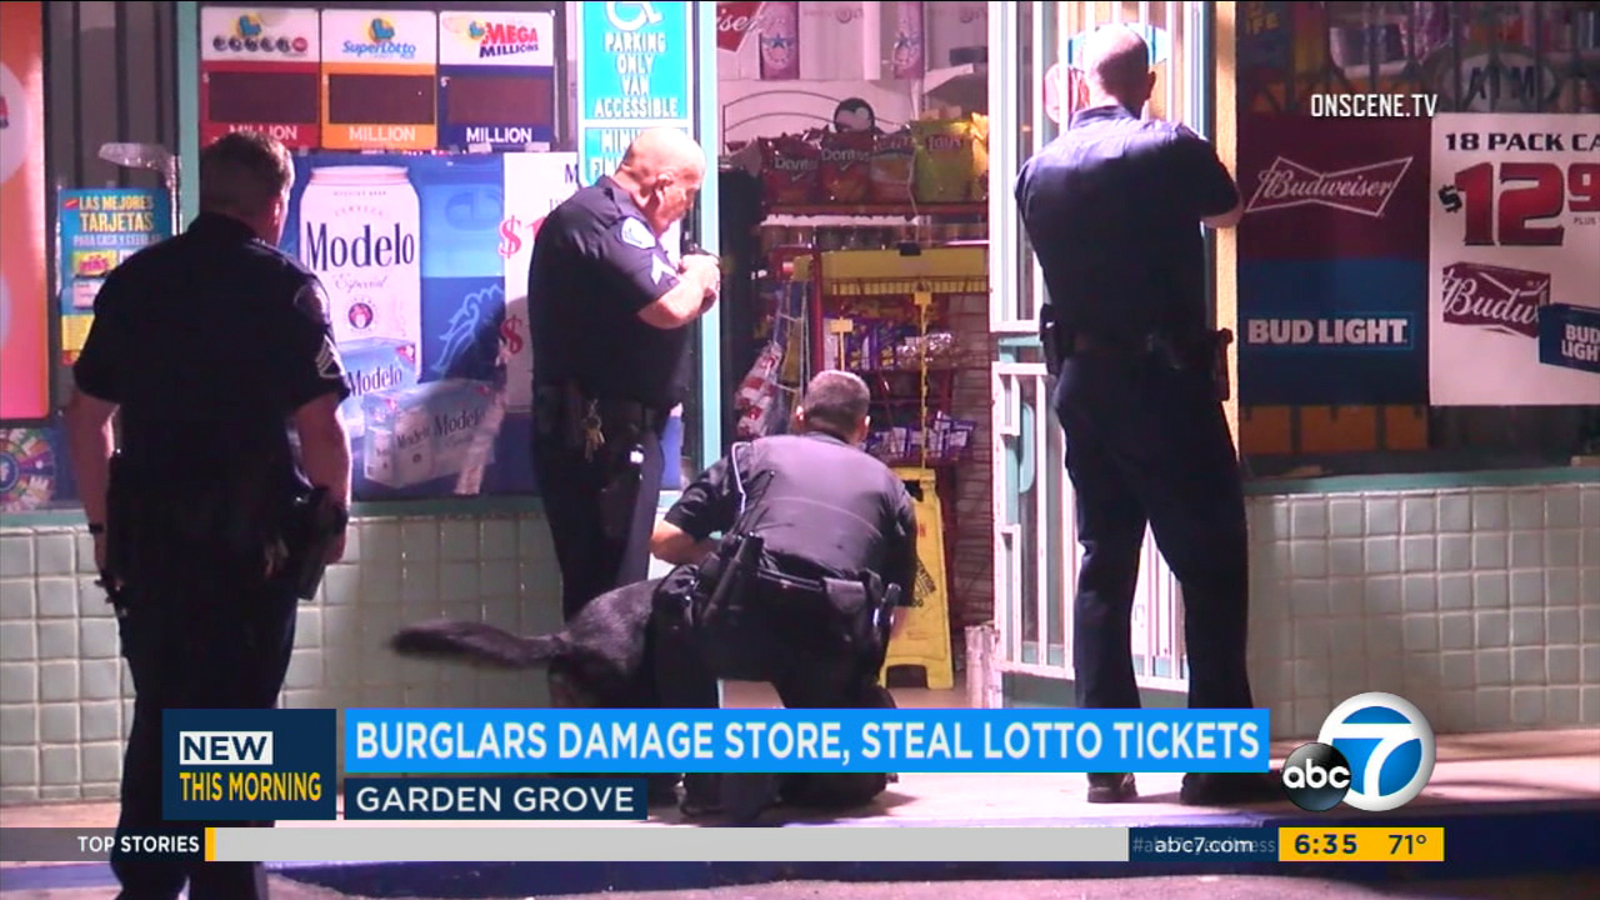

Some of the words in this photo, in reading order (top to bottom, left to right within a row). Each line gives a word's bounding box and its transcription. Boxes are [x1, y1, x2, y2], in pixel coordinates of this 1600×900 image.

[480, 21, 539, 44] MEGA
[603, 32, 666, 52] PARKING
[479, 44, 539, 58] MILLIONS
[616, 54, 655, 74] ONLY
[621, 75, 651, 95] VAN
[594, 97, 680, 118] ACCESSIBLE
[349, 127, 416, 141] MILLION
[466, 127, 532, 143] MILLION
[1446, 133, 1480, 150] 18
[1488, 133, 1565, 151] PACK
[1258, 169, 1394, 199] Budweiser
[79, 196, 100, 211] LAS
[102, 195, 154, 211] MEJORES
[80, 212, 154, 232] TARJETAS
[305, 221, 415, 272] Modelo
[1248, 318, 1314, 344] BUD
[1318, 318, 1407, 344] LIGHT
[1565, 323, 1600, 345] BUD
[1561, 339, 1600, 362] LIGH
[348, 364, 403, 397] Modelo
